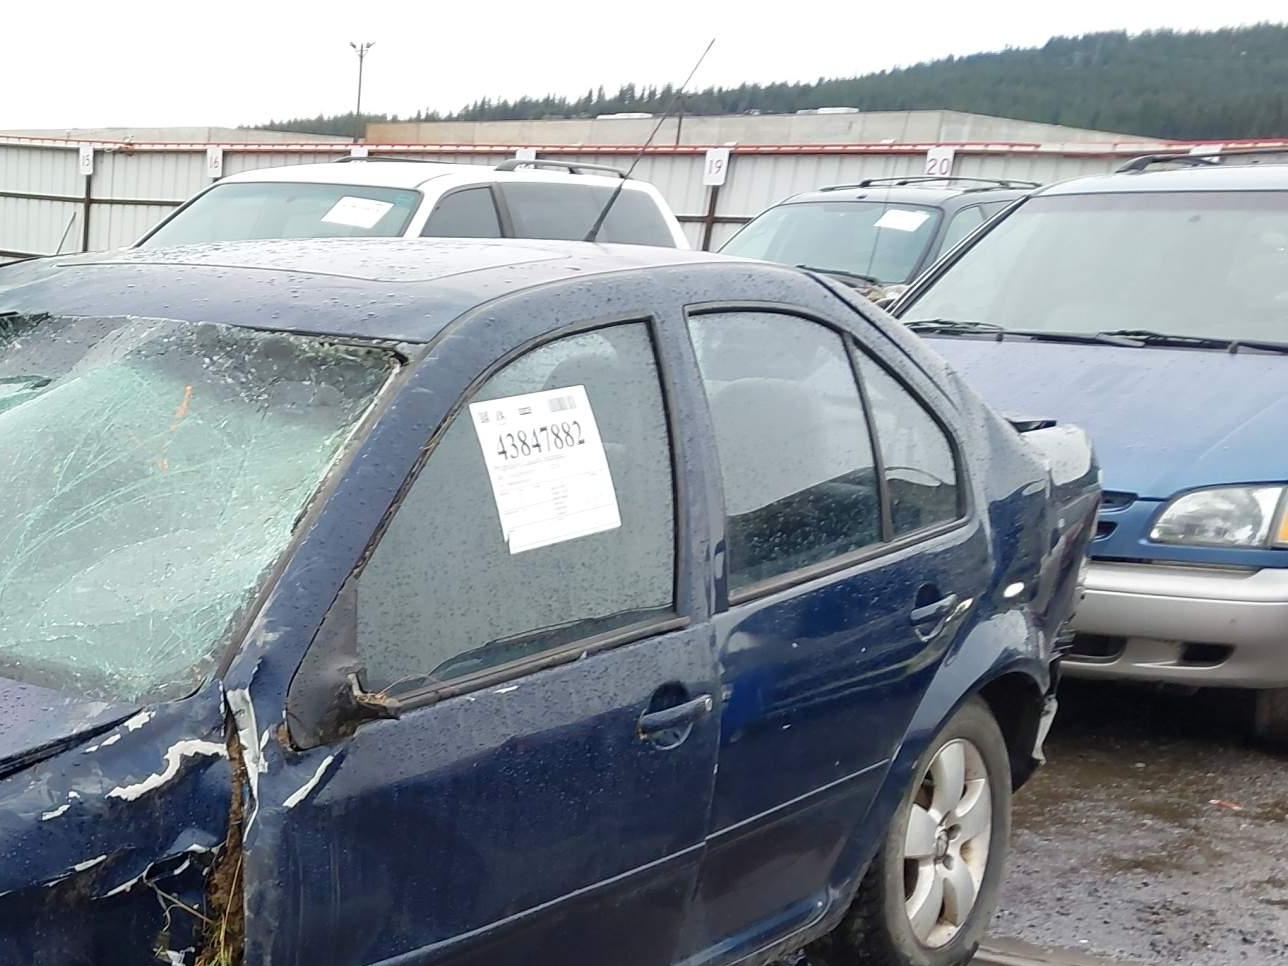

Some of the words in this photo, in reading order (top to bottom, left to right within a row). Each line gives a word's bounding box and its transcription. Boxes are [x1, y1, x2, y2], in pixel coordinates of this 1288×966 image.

[708, 159, 723, 175] 19
[926, 158, 950, 175] 20
[496, 420, 585, 460] 43847882
